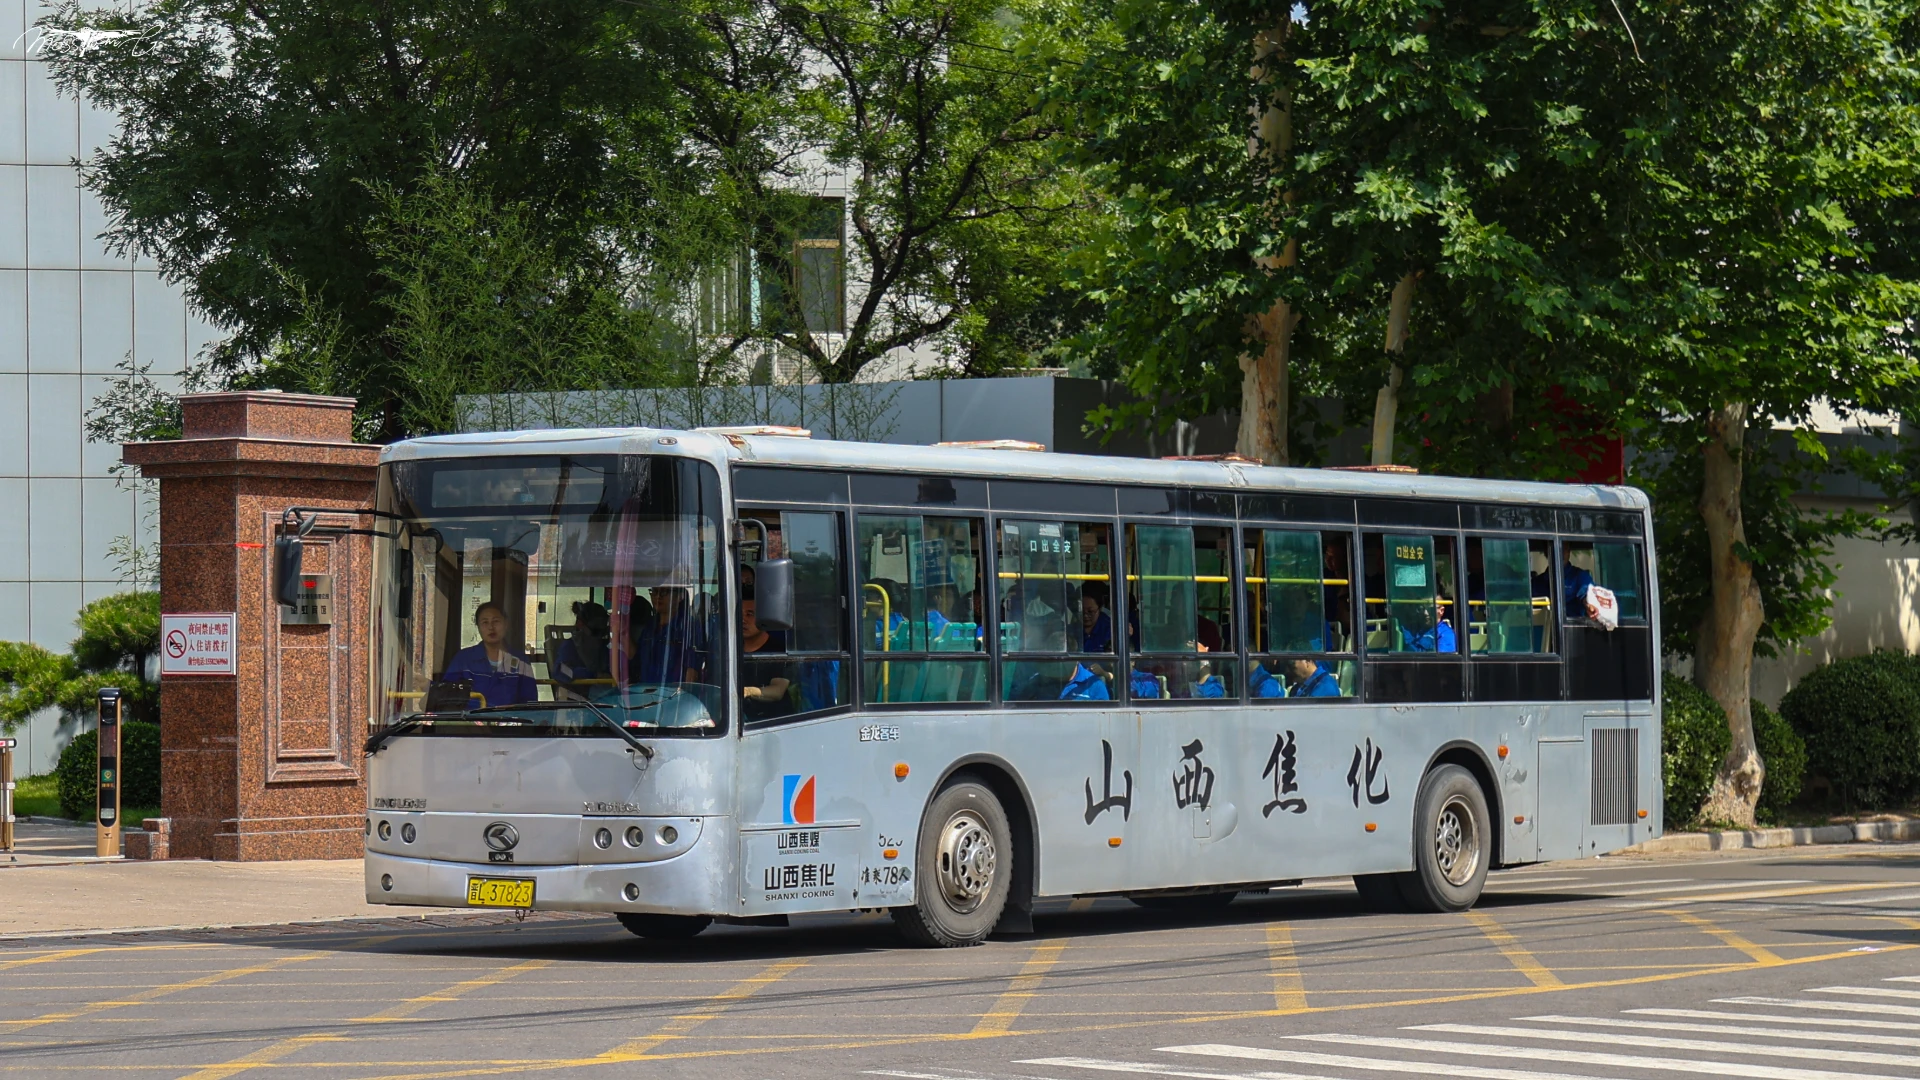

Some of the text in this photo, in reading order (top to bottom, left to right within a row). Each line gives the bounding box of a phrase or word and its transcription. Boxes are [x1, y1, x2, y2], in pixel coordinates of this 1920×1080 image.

[859, 724, 900, 742] 金龙客车
[1084, 730, 1390, 826] 山西焦化
[778, 831, 820, 849] 山西焦煤
[764, 863, 835, 891] 山西焦化
[765, 889, 835, 902] SHANXI COKING
